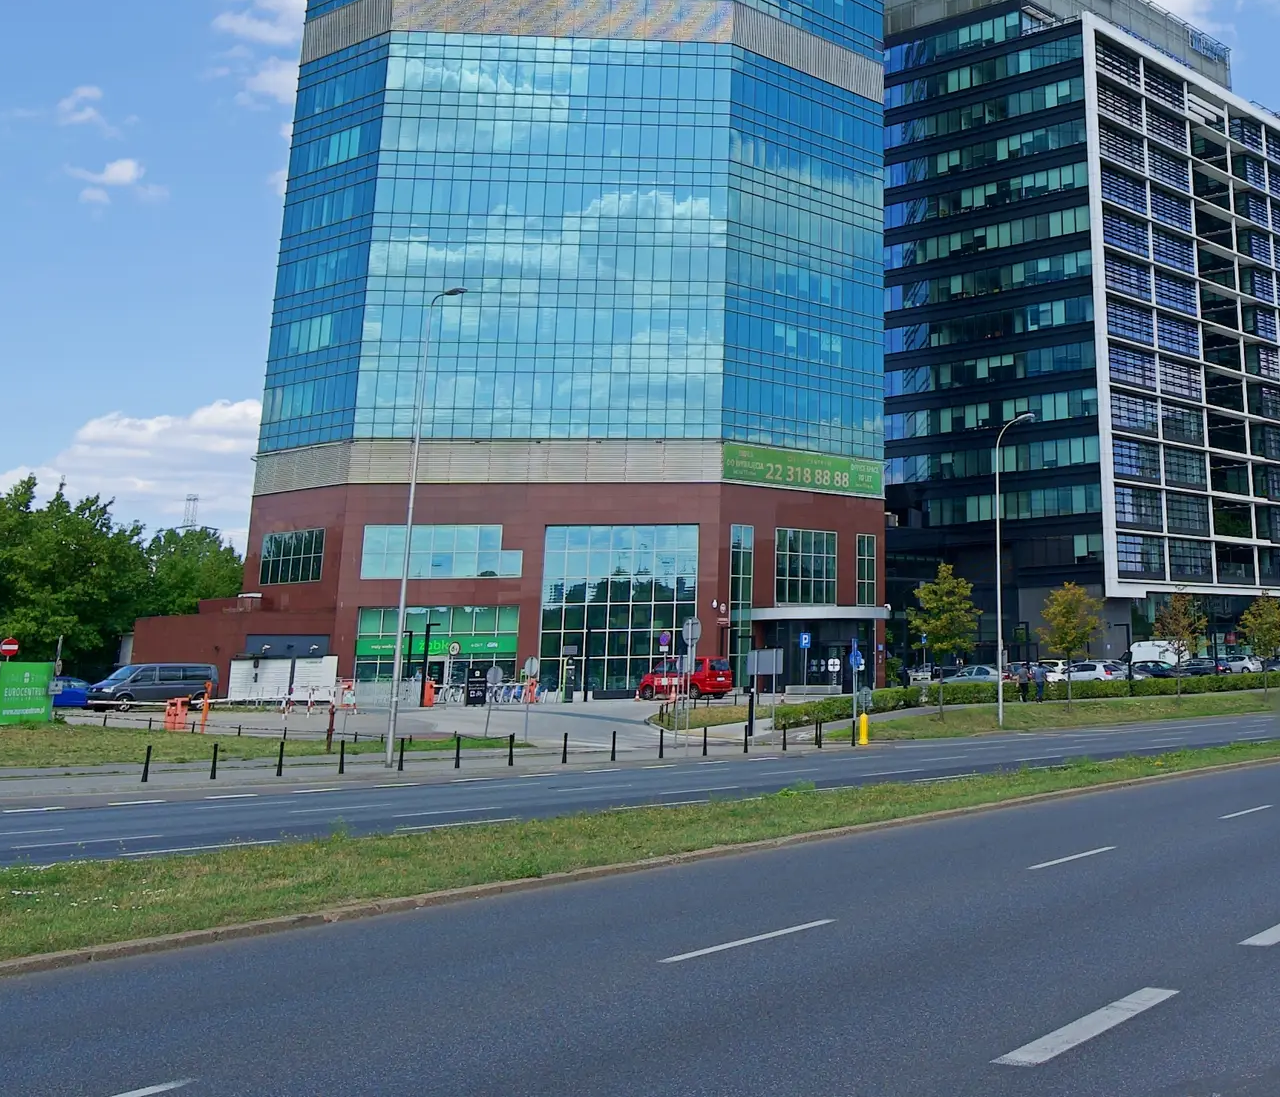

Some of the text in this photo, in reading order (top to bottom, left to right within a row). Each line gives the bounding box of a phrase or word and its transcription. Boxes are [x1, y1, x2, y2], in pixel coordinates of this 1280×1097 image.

[765, 462, 850, 488] 22 318 88 88
[419, 640, 450, 652] żabk
